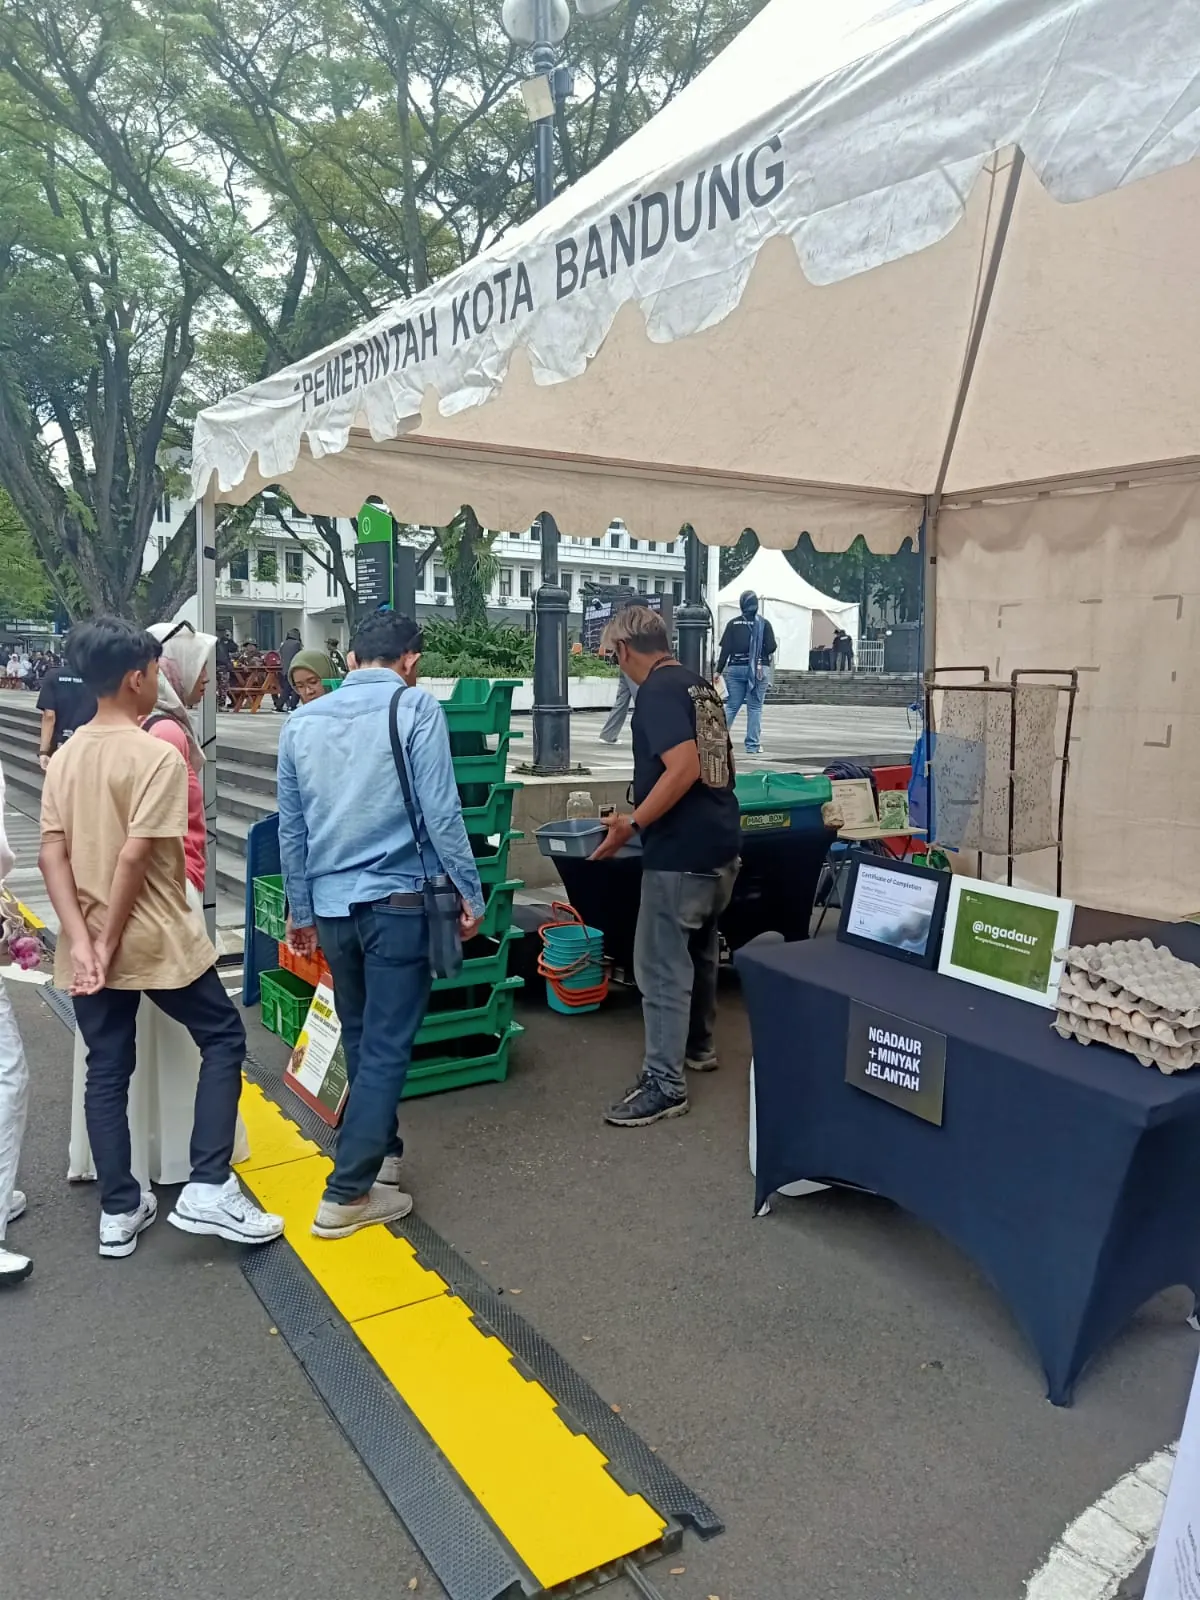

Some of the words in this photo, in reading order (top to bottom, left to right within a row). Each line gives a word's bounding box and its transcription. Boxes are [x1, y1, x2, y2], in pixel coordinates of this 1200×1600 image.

[300, 312, 438, 412] PEMERINTAH
[451, 261, 534, 346] KOTA
[555, 134, 785, 300] BANDUNG
[892, 879, 922, 892] Completion
[972, 920, 1038, 946] @ngadaur
[868, 1026, 922, 1056] NGADAUR
[865, 1061, 920, 1092] JELANTAH
